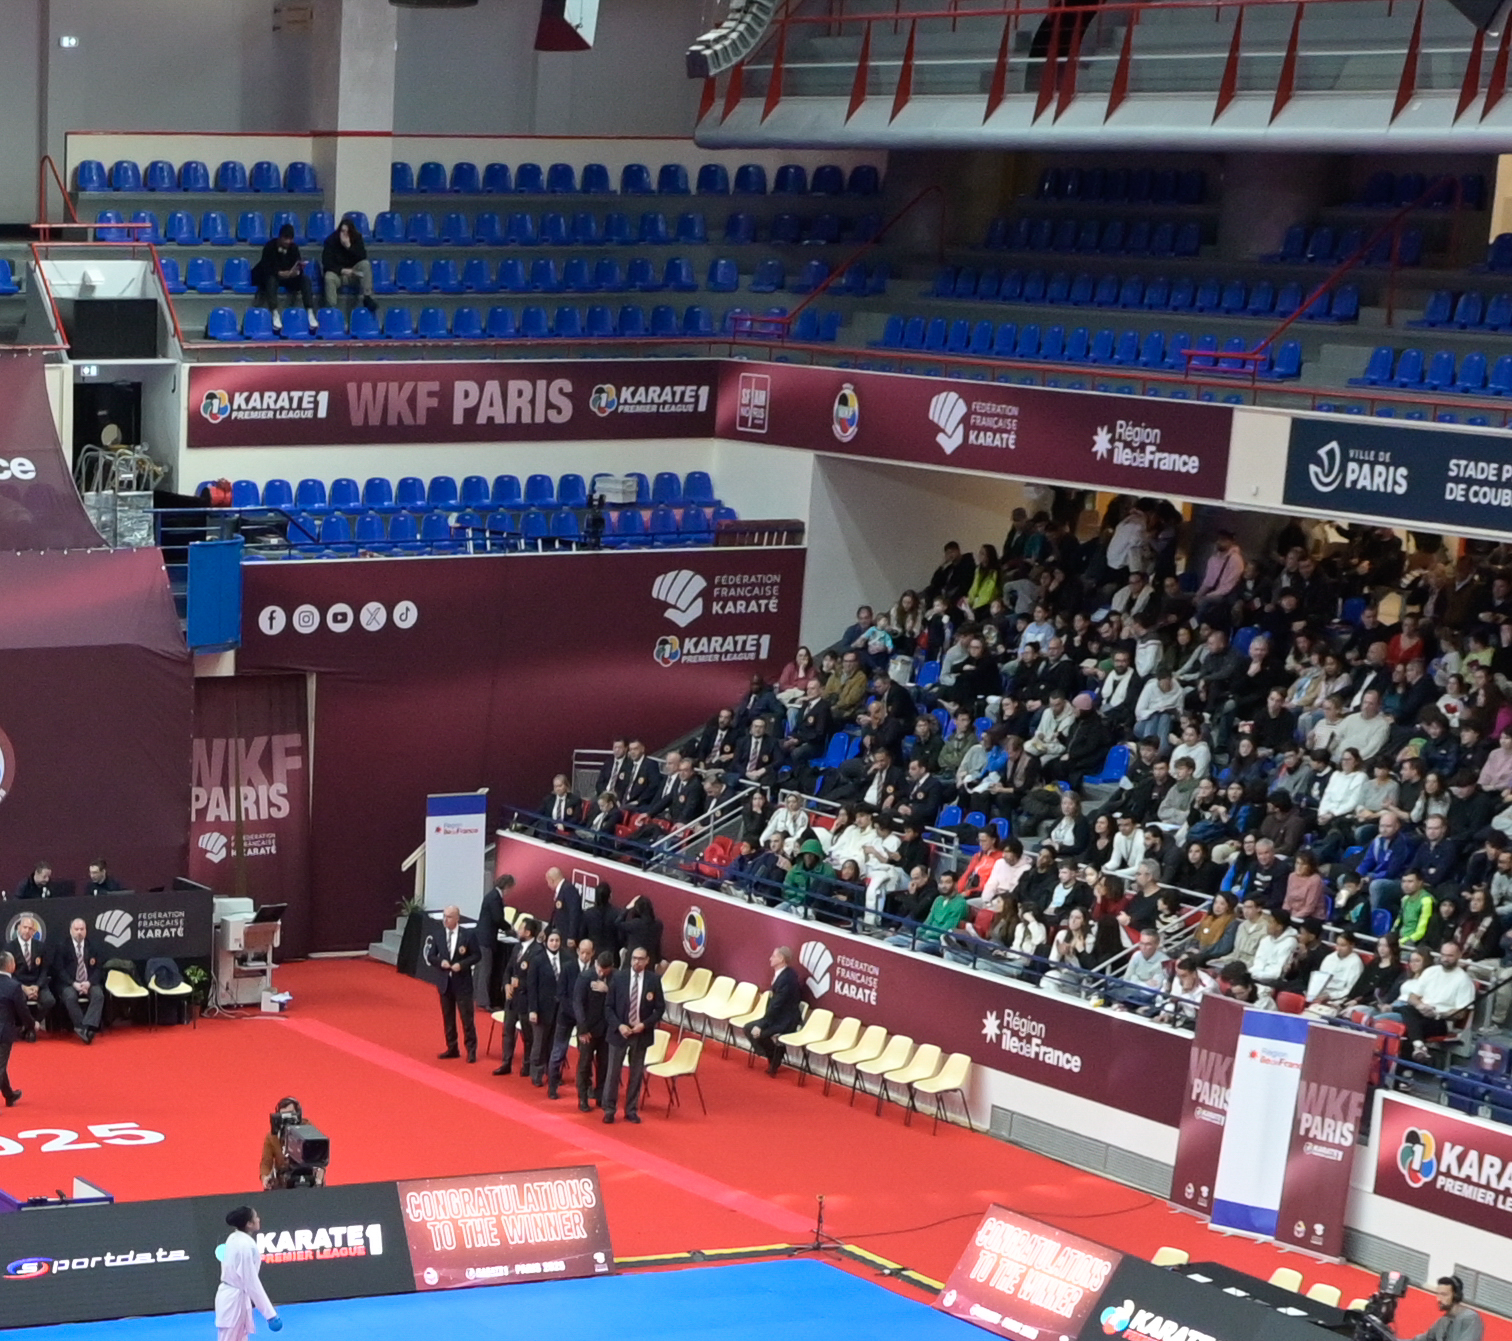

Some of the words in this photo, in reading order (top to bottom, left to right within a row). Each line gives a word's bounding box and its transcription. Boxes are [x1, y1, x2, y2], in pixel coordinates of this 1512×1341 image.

[347, 381, 440, 426] WKF
[453, 379, 574, 425] PARIS
[618, 404, 657, 413] PREMIER
[660, 403, 694, 412] LEAGUE
[971, 401, 1019, 417] FÉDÉRATION
[232, 409, 274, 420] PREMIER
[277, 408, 314, 419] LEAGUE
[970, 415, 1018, 431] FRANÇAISE
[968, 430, 1017, 449] KARATÉ
[1115, 420, 1161, 445] Région
[1349, 449, 1375, 461] VILLE
[1378, 451, 1391, 463] DE
[1345, 462, 1409, 495] PARIS
[1448, 459, 1499, 481] STADE
[1445, 483, 1467, 501] DE
[714, 574, 781, 585] FÉDÉRATION
[713, 585, 780, 598] FRANÇAISE
[712, 597, 779, 615] KARATÉ
[681, 653, 720, 664] PREMIER
[721, 652, 756, 661] LEAGUE
[190, 782, 290, 822] PARIS
[137, 926, 185, 939] KARATÉ
[837, 955, 880, 976] FÉDÉRATION
[835, 967, 879, 989] FRANÇAISE
[834, 979, 878, 1006] KARATÉ
[1003, 1008, 1046, 1039] Région
[1299, 1112, 1354, 1147] PARIS
[405, 1177, 596, 1223] CONGRATULATIONS
[1436, 1175, 1494, 1207] PREMIER
[426, 1219, 457, 1252] TO
[459, 1215, 501, 1248] THE
[500, 1210, 588, 1246] WINNER
[315, 1245, 366, 1261] LEAGUE
[975, 1216, 1112, 1293] CONGRATULATIONS
[969, 1248, 995, 1284] TO
